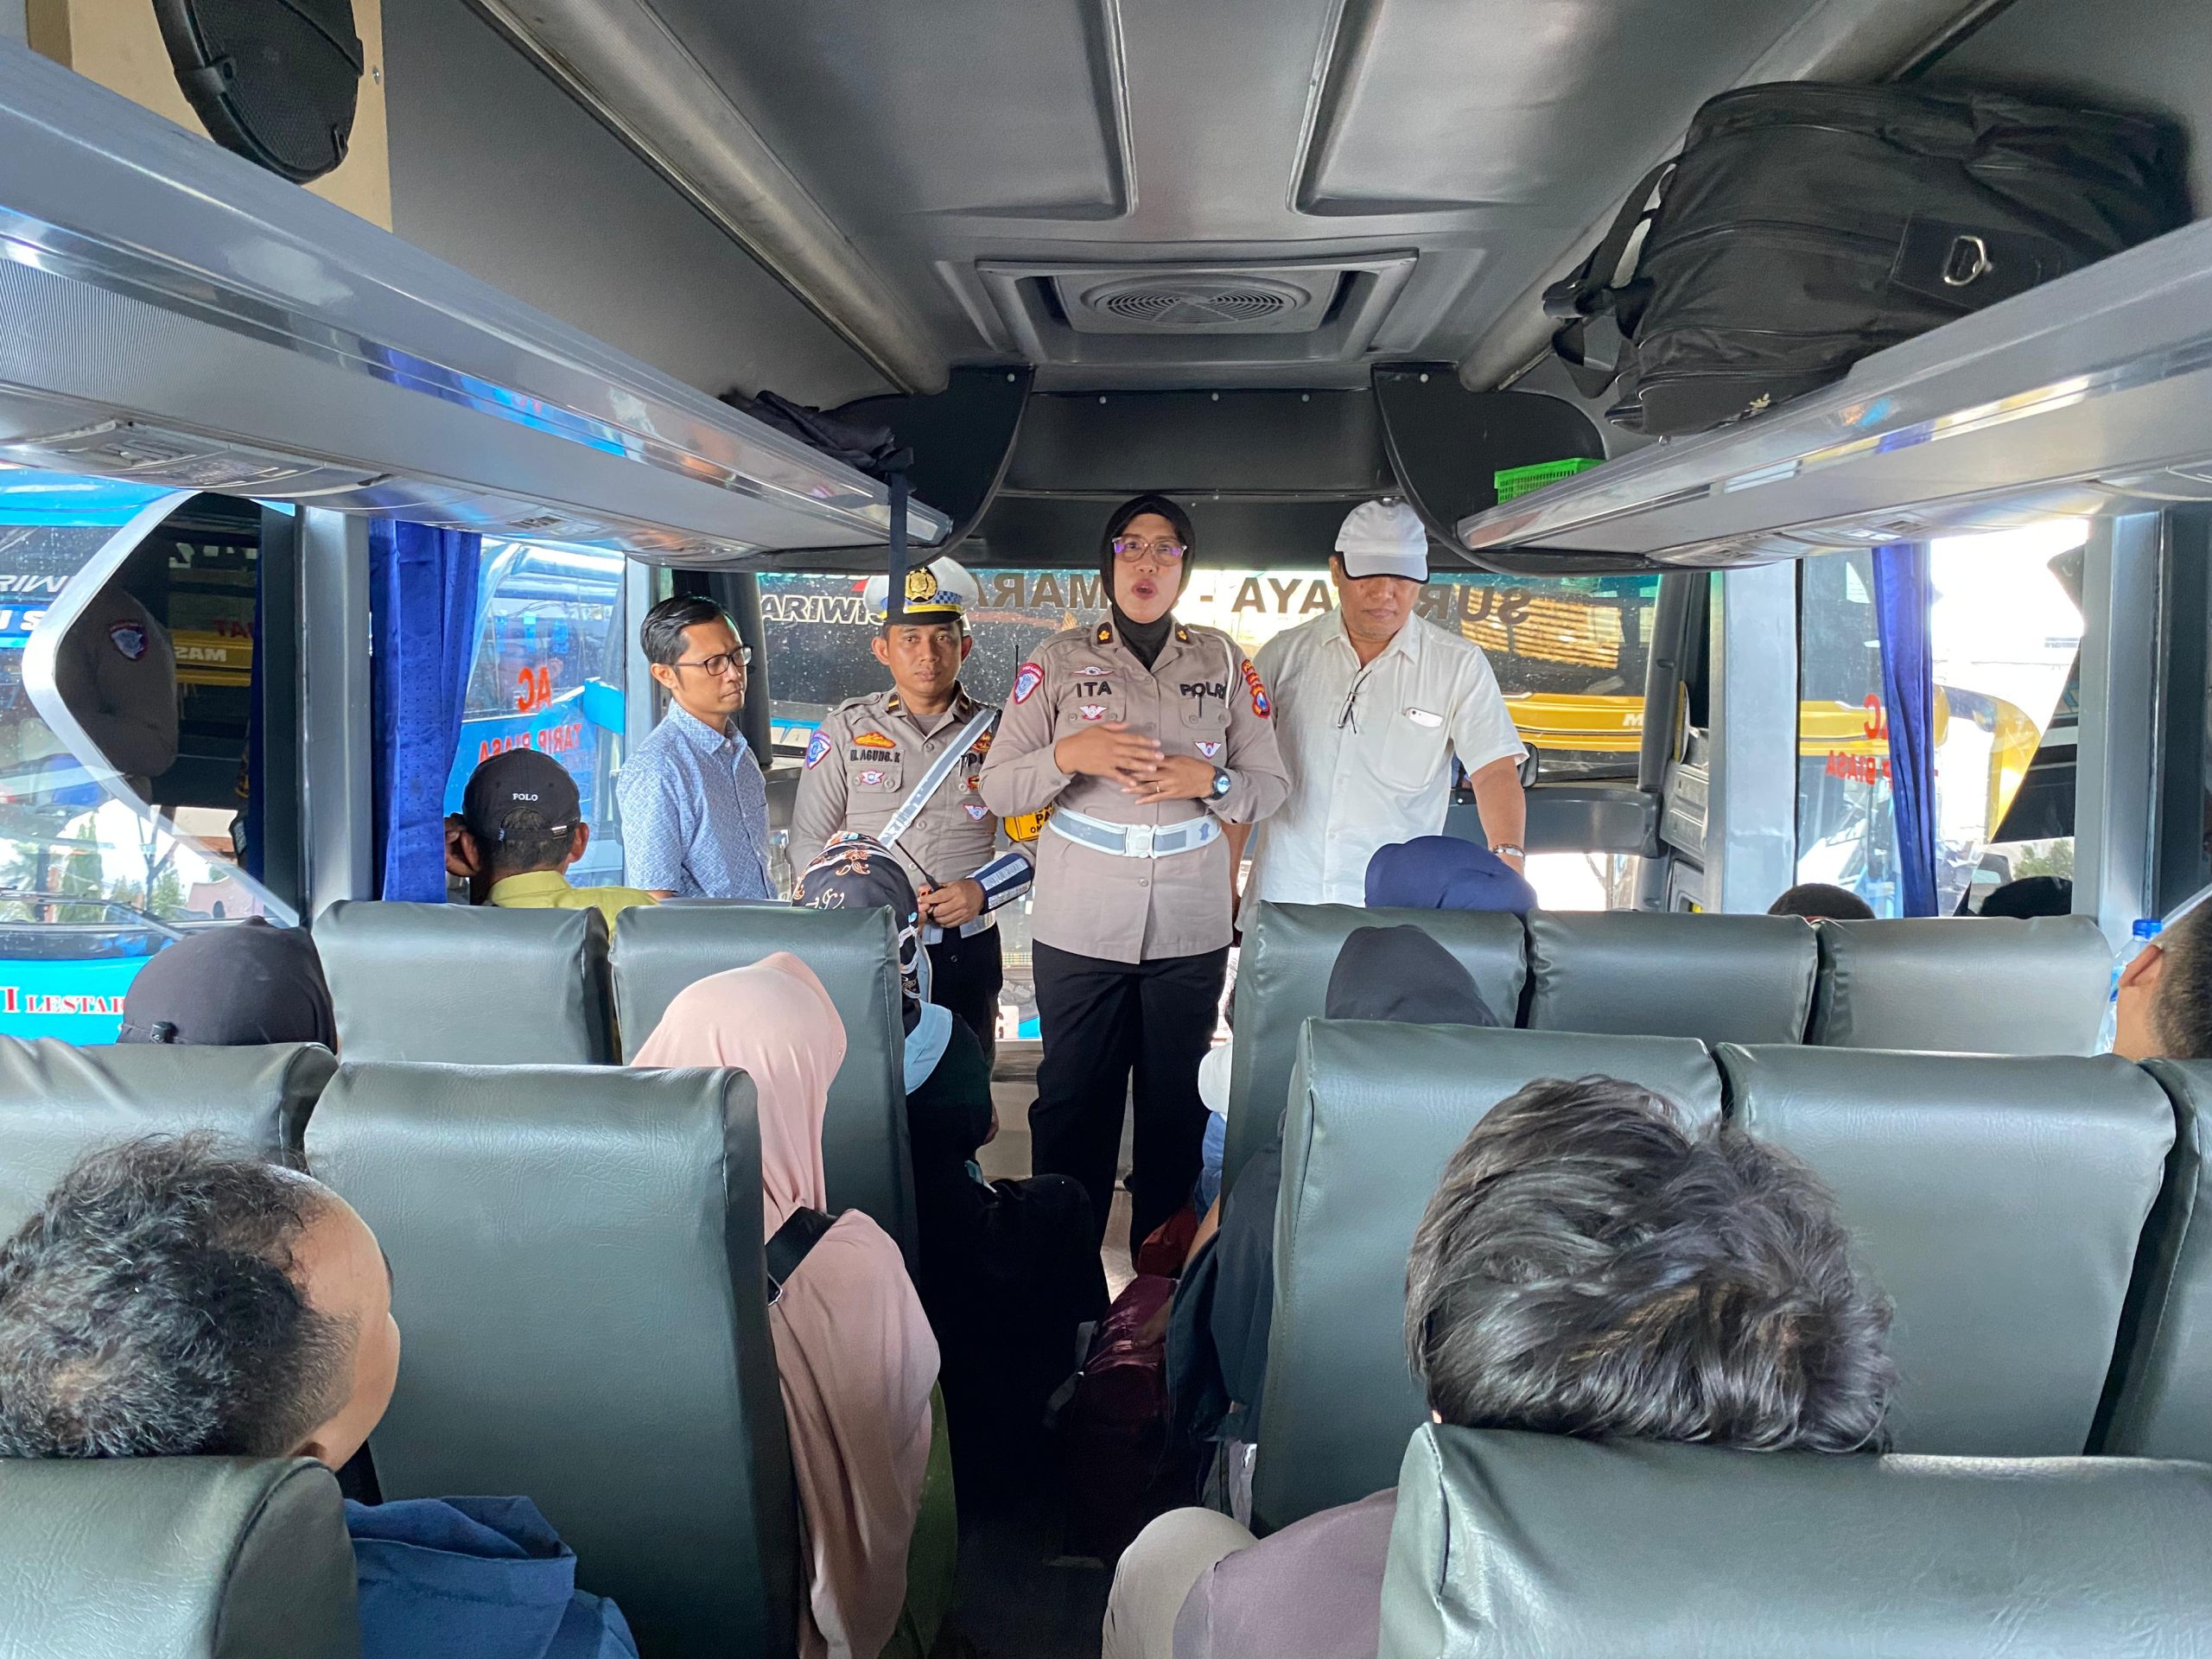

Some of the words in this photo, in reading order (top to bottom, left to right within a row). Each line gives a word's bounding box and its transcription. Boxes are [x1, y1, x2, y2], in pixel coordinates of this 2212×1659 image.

[1077, 681, 1112, 697] ITA
[512, 792, 538, 802] POLO
[25, 995, 124, 1014] LESTAR
